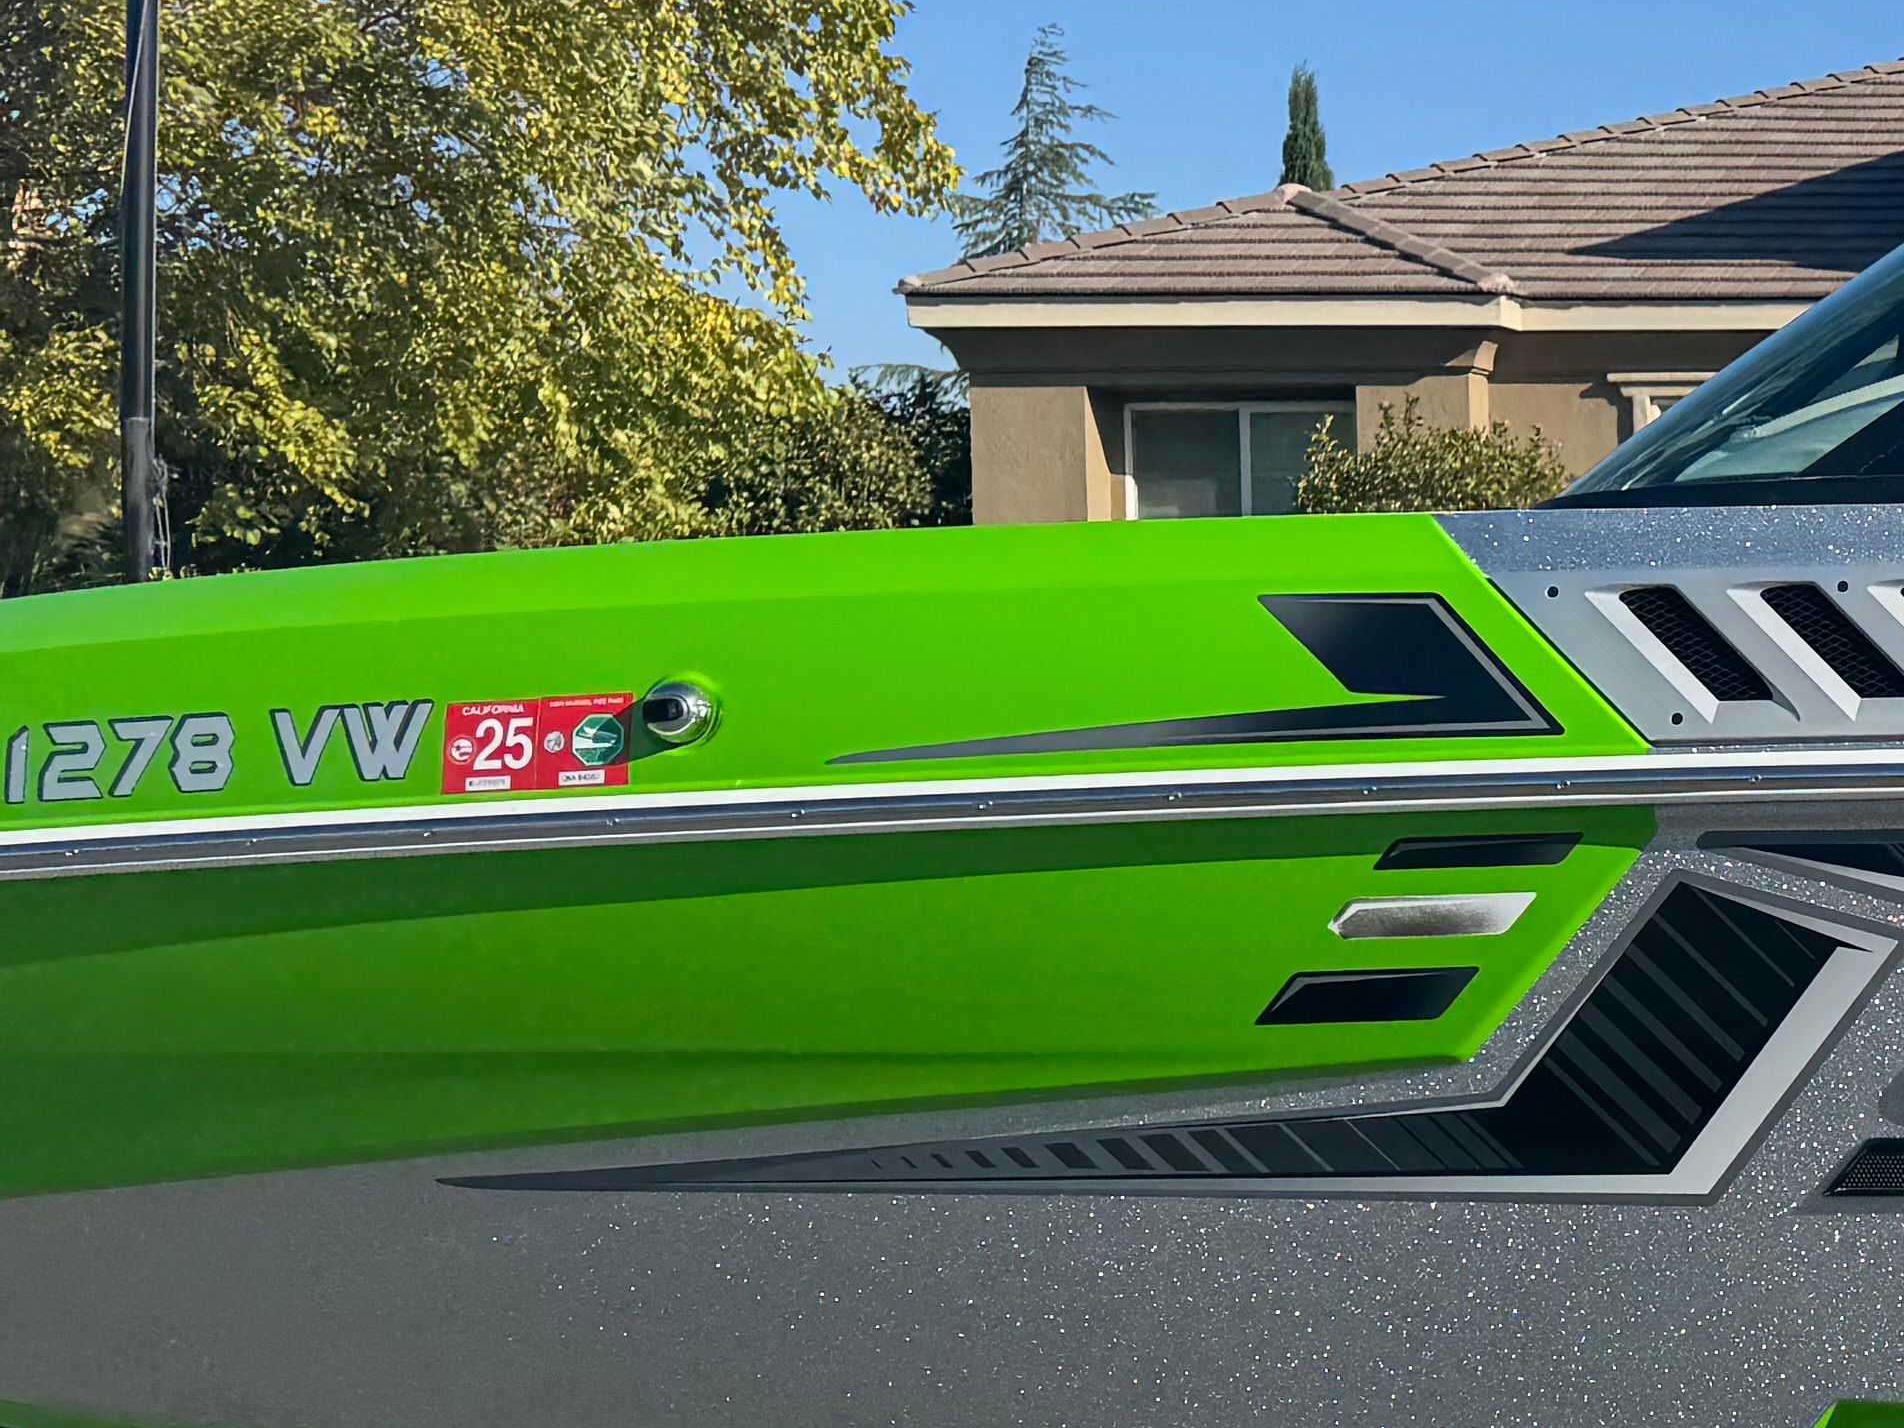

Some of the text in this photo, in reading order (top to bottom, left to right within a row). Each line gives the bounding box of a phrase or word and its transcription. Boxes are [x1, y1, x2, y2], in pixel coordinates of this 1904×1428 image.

[461, 703, 525, 716] CALIFORNIA
[4, 697, 435, 805] 1278 VW
[473, 717, 534, 771] 25
